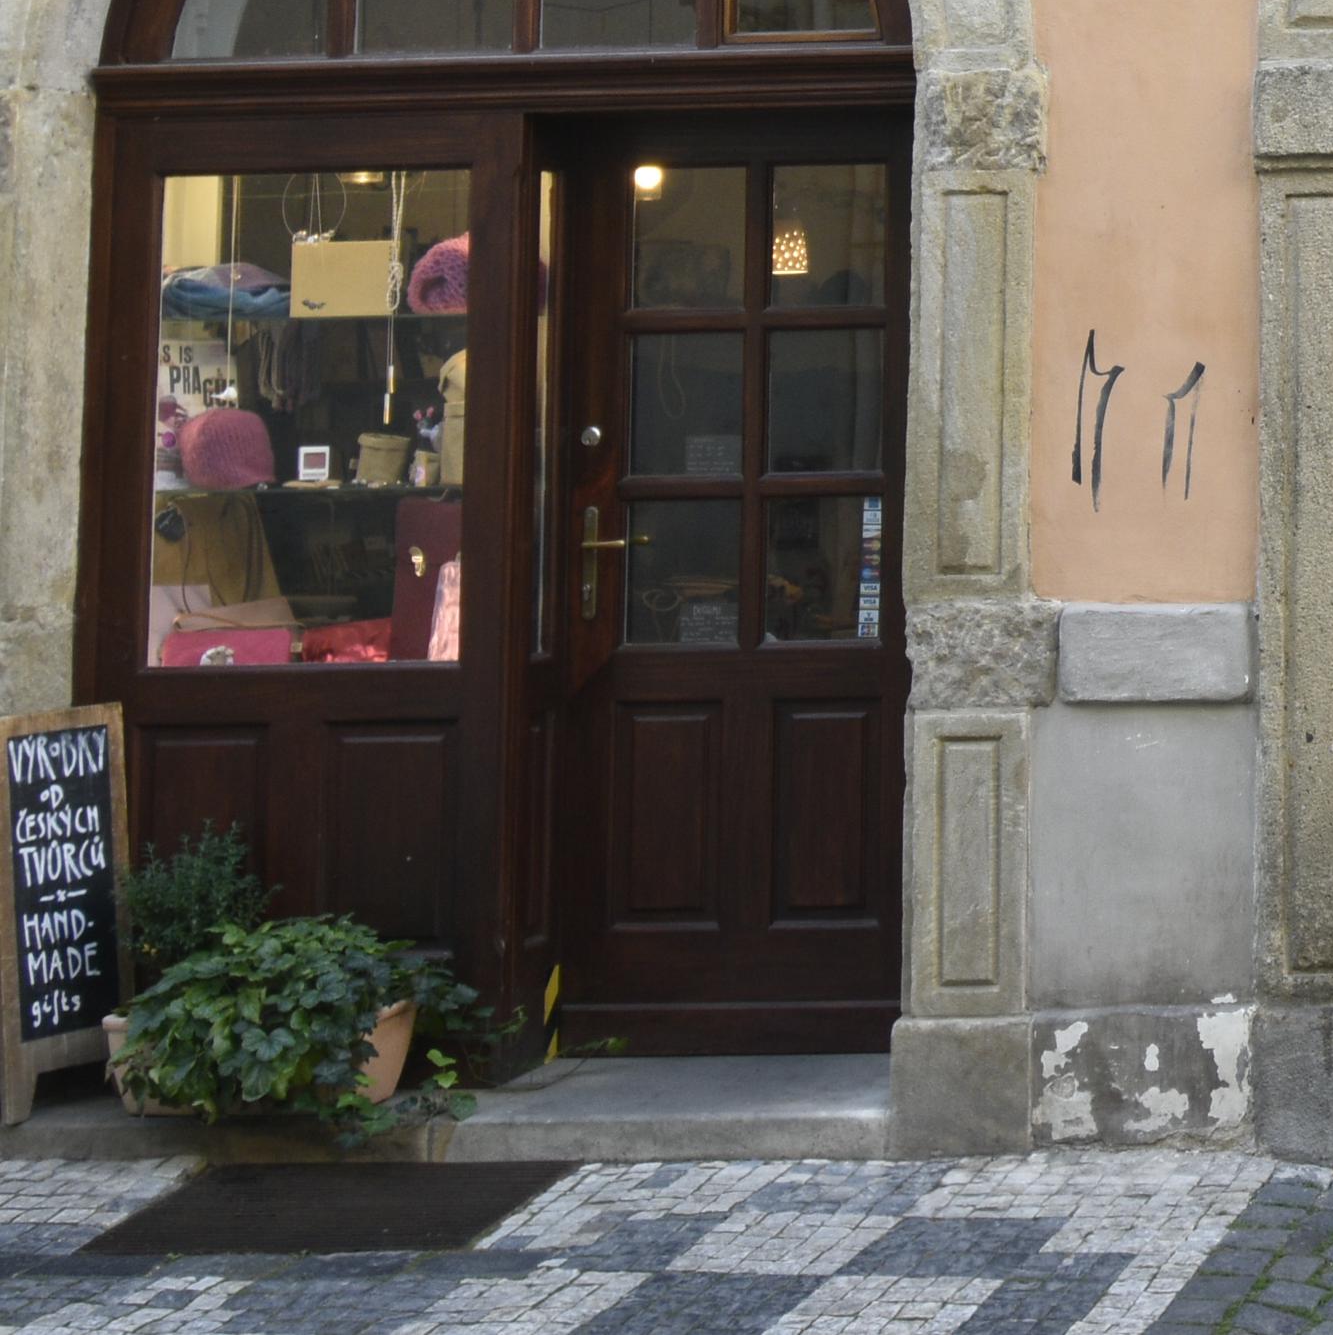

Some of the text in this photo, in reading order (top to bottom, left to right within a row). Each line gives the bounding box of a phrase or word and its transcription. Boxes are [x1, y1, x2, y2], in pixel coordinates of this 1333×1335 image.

[178, 345, 193, 364] IS
[27, 942, 101, 986] MADE
[32, 989, 82, 1029] gifts
